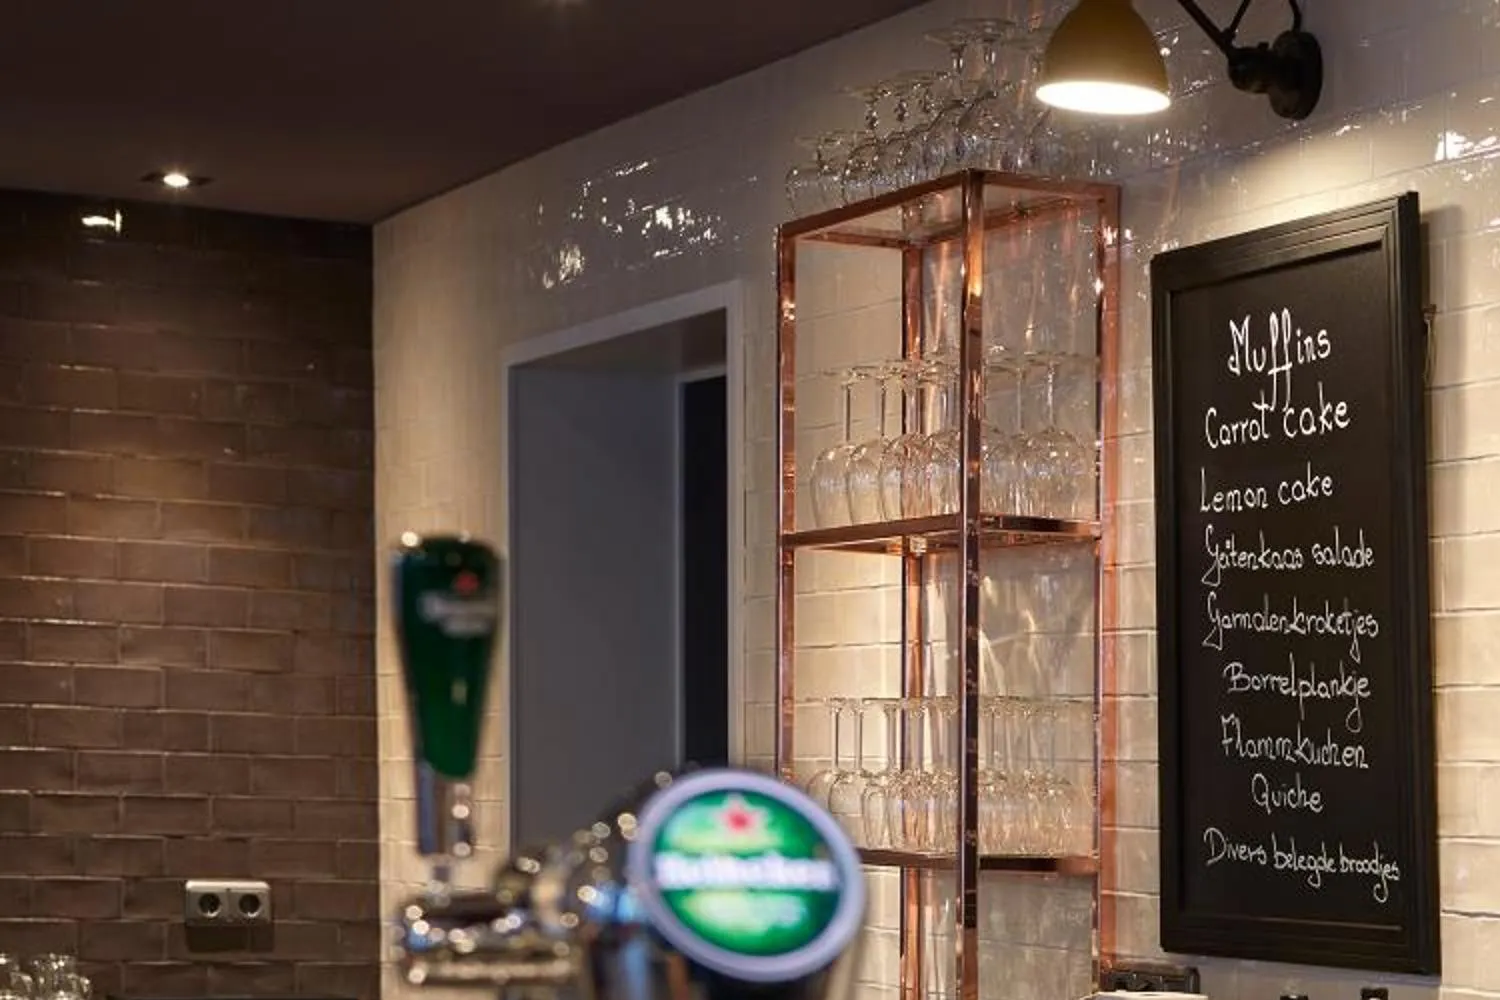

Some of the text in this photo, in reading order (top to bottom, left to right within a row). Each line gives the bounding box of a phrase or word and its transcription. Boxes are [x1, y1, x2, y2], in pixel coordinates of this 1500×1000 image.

[1227, 307, 1332, 411] Muffins
[1205, 381, 1350, 449] Carrot cake
[1200, 461, 1333, 513] Lemon cake
[1201, 523, 1375, 587] Geitenkaas salade
[1223, 651, 1371, 733] Borrelplankje
[1252, 772, 1324, 814] Quiche
[1203, 826, 1401, 903] Divers belegde broodjes
